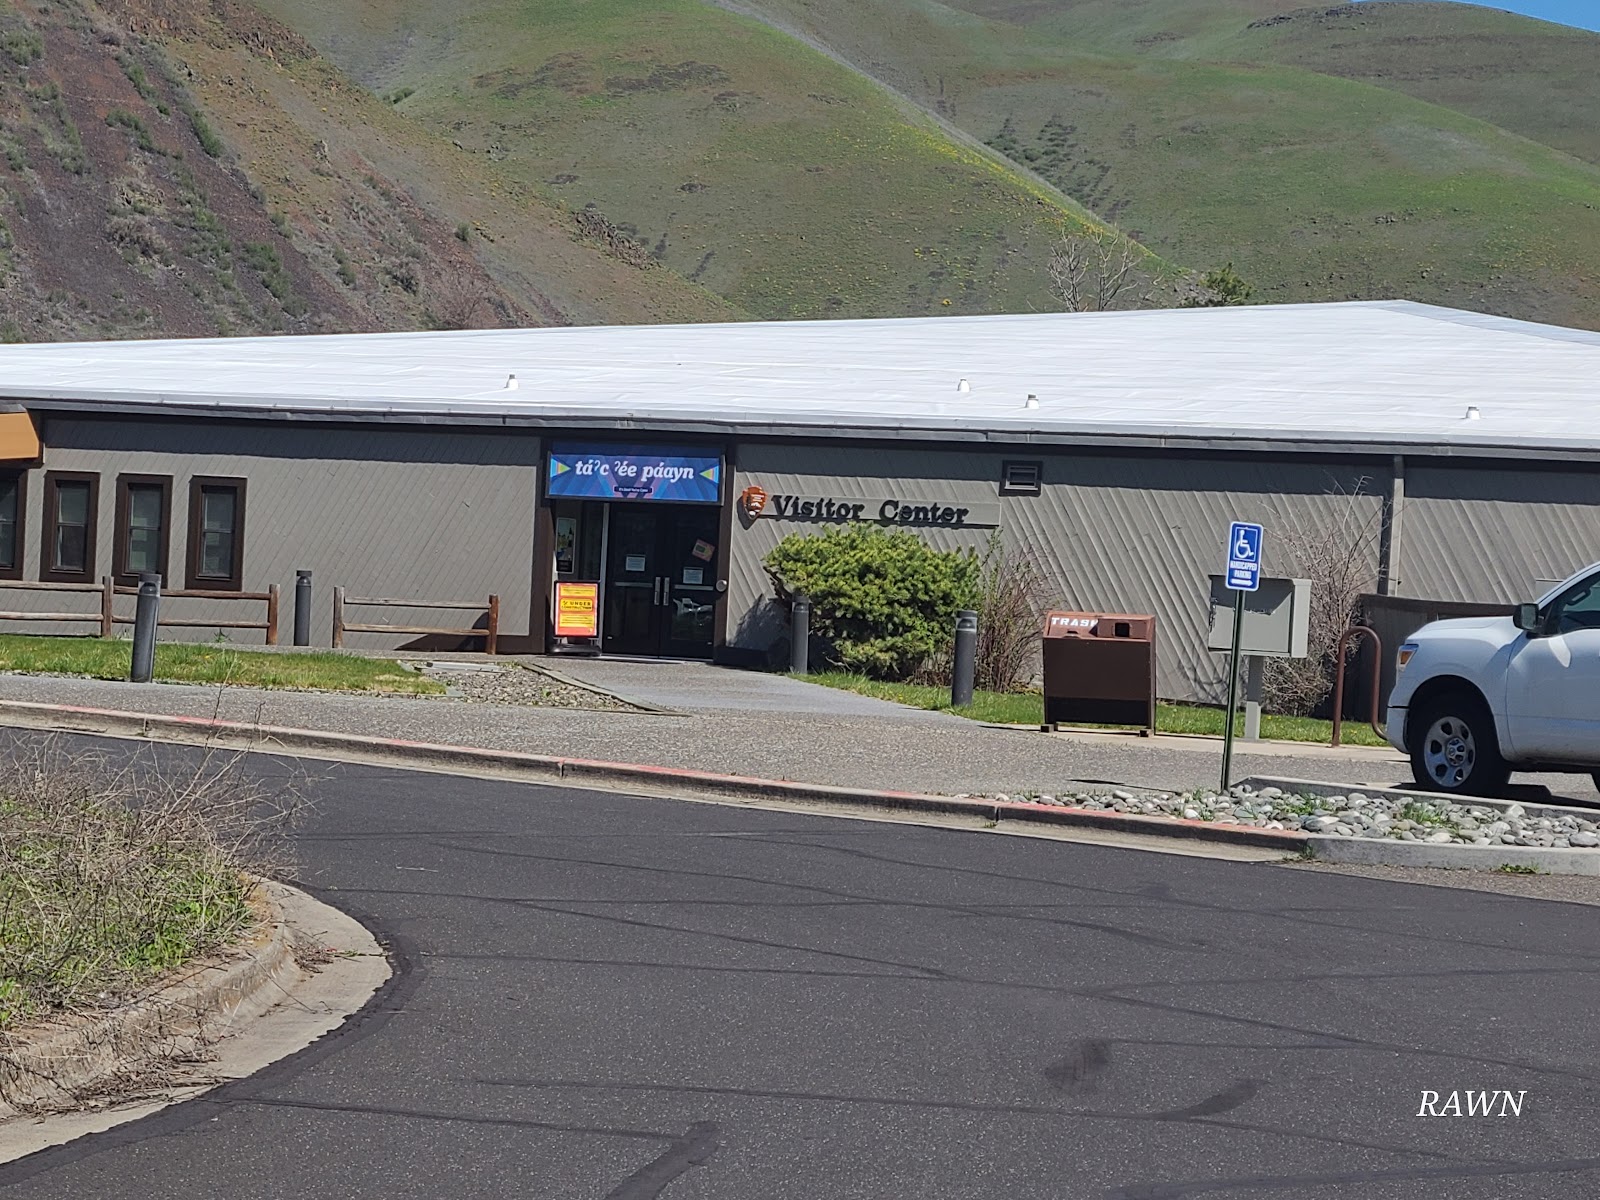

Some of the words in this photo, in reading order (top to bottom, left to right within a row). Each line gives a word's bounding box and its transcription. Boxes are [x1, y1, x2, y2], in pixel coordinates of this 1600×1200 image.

[641, 461, 695, 484] páayn
[771, 494, 865, 520] Visitor
[878, 499, 970, 524] Center
